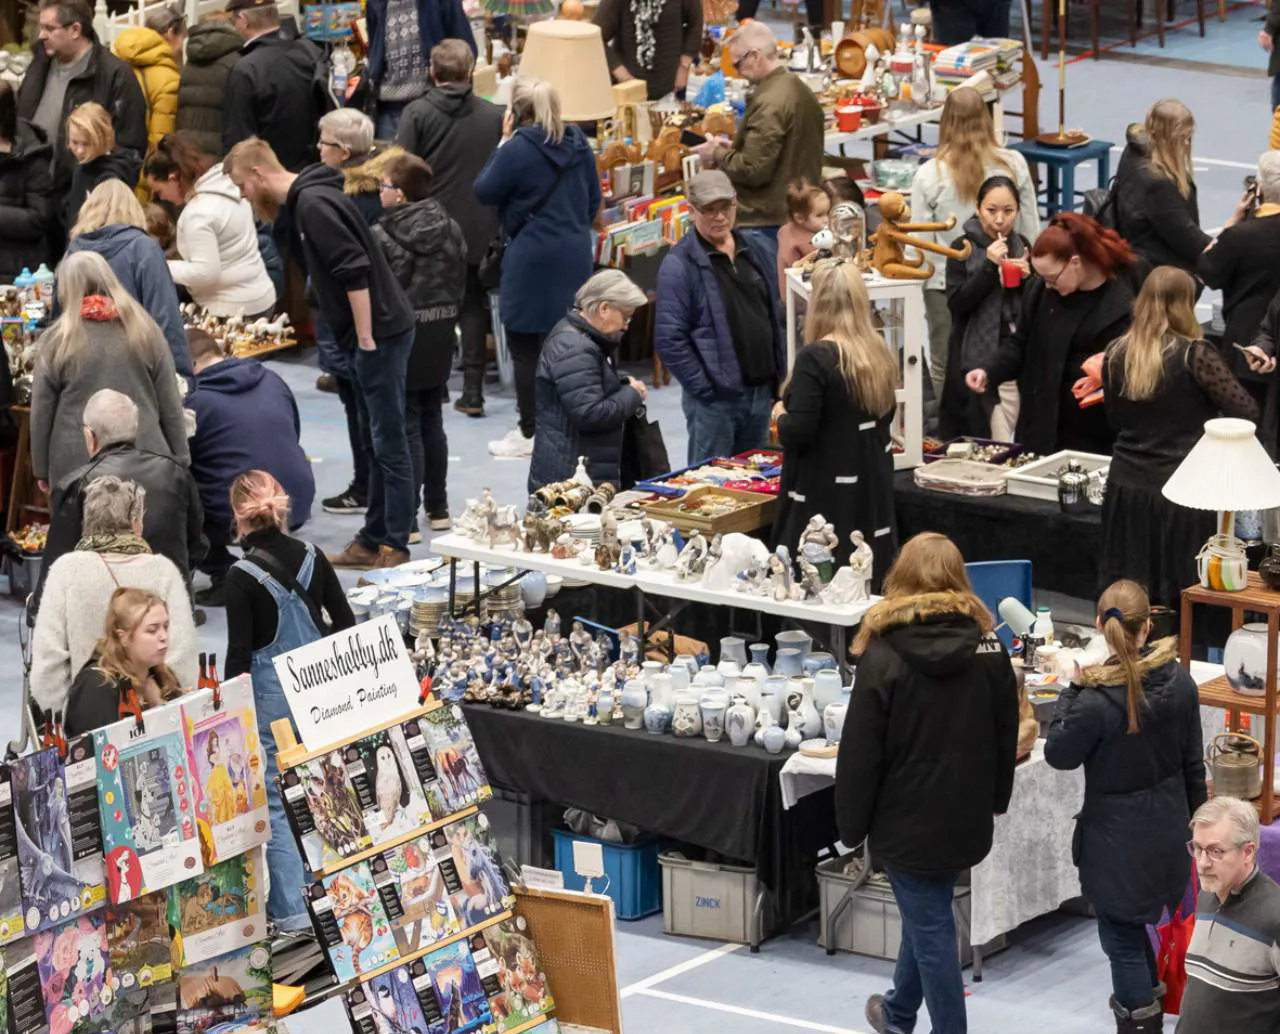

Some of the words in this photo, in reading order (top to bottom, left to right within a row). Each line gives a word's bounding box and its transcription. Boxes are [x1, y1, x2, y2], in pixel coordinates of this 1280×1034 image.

[286, 624, 398, 693] Sanneshobby.dk
[310, 695, 354, 724] Diamond
[356, 682, 398, 708] Painting
[695, 896, 721, 909] ZINCK
